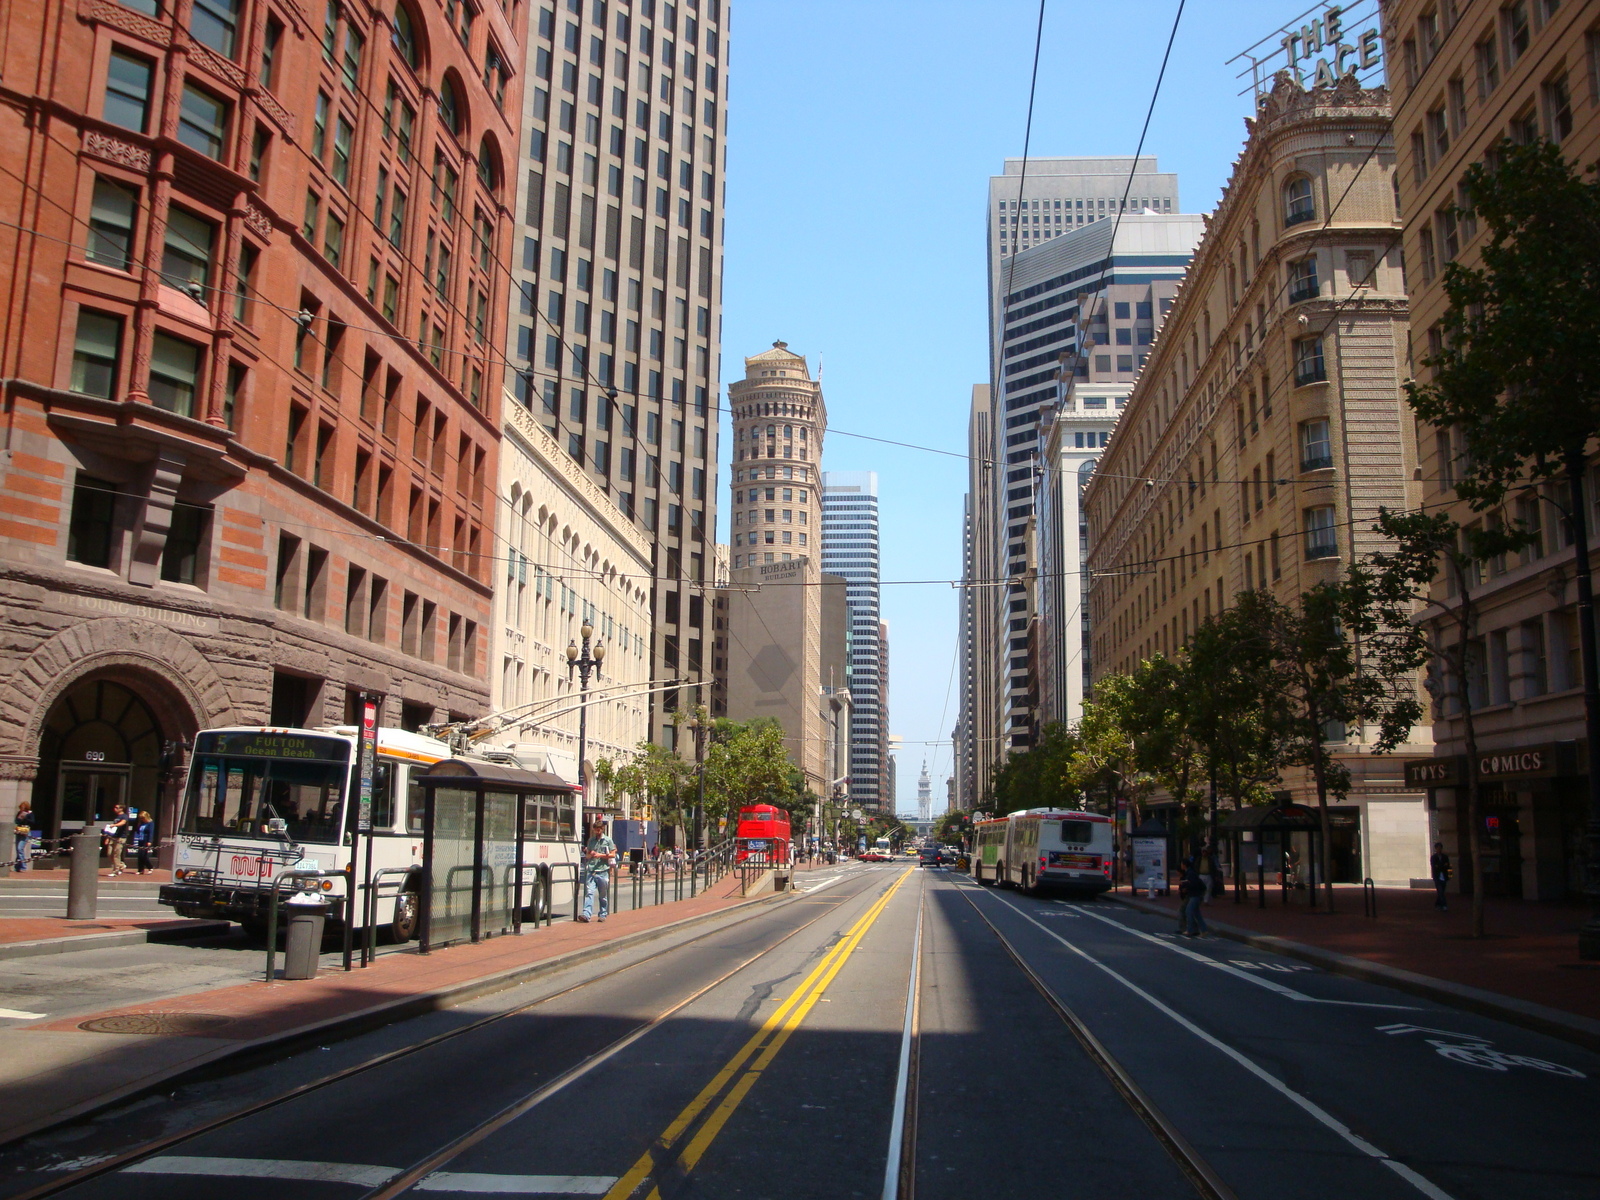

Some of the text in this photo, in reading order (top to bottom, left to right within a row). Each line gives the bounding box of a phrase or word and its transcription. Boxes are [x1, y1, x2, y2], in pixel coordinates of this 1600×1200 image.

[1281, 5, 1344, 67] THE
[760, 560, 802, 575] HOBART
[765, 571, 797, 581] BUILDING
[136, 606, 207, 628] BUILDING
[217, 735, 305, 752] 5 FULTON
[86, 751, 105, 761] 690
[245, 746, 315, 758] Ocean Beach
[1480, 753, 1541, 774] COMICS
[1412, 764, 1446, 780] TOYS
